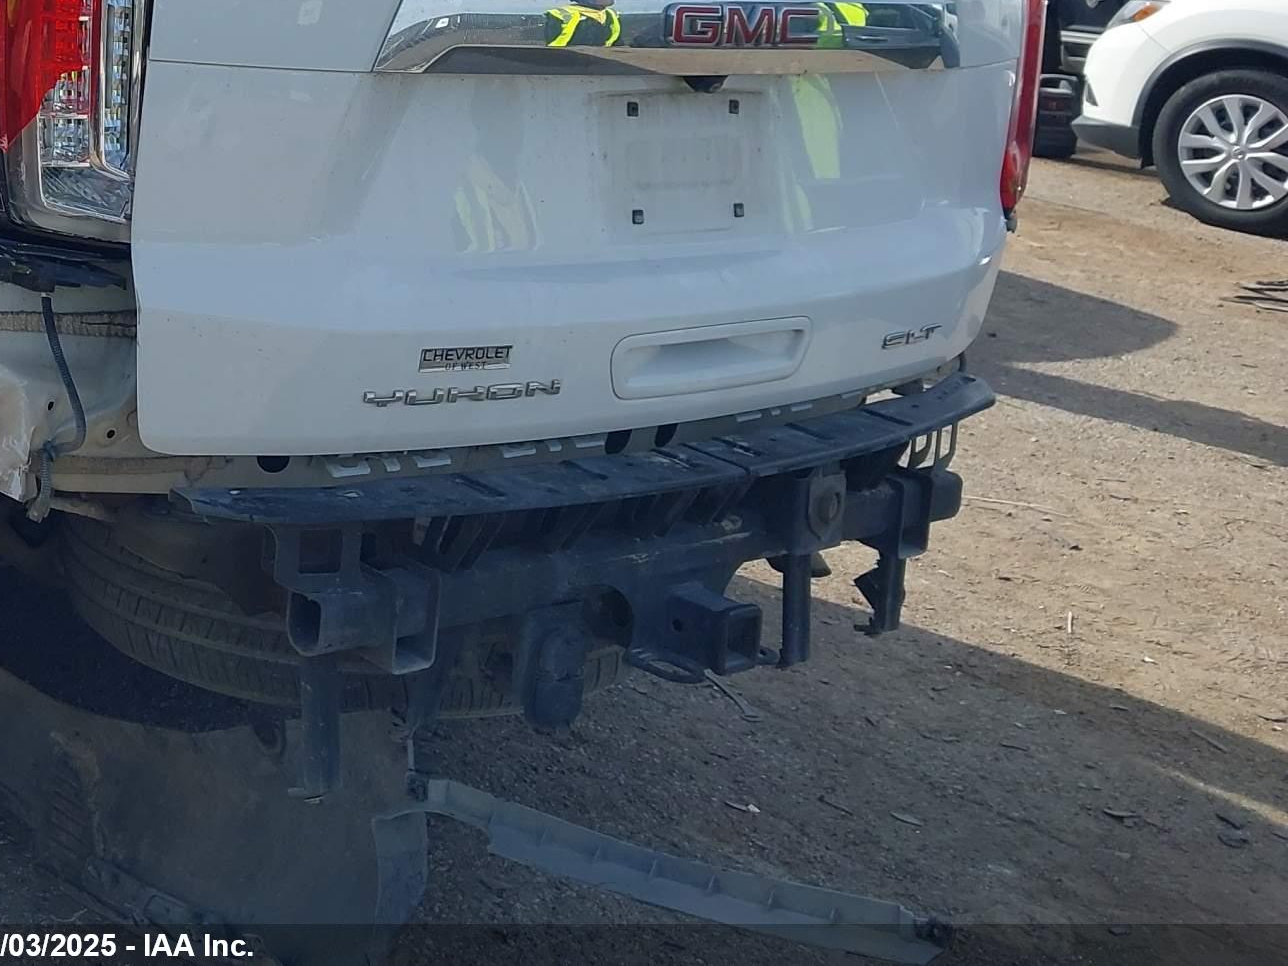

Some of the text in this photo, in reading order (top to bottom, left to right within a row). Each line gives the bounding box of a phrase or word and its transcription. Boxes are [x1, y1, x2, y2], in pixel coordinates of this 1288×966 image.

[672, 5, 832, 48] GMC
[422, 346, 512, 362] CHEVROLET
[363, 379, 561, 407] YUKON
